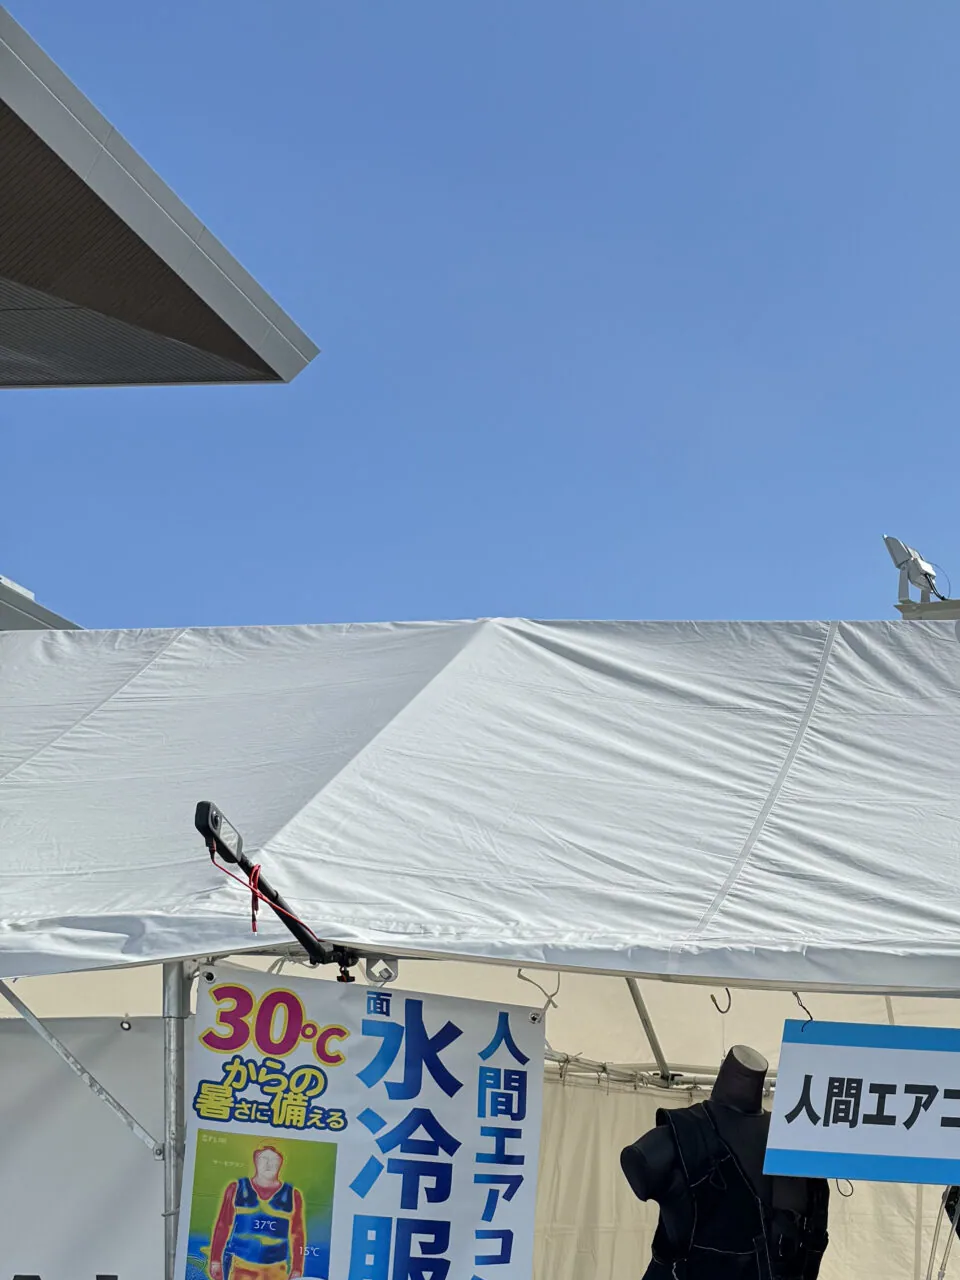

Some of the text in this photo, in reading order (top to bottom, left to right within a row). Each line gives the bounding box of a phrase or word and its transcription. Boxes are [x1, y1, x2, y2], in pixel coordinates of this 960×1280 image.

[223, 1056, 327, 1097] からの
[194, 1082, 347, 1132] 暑さに備える
